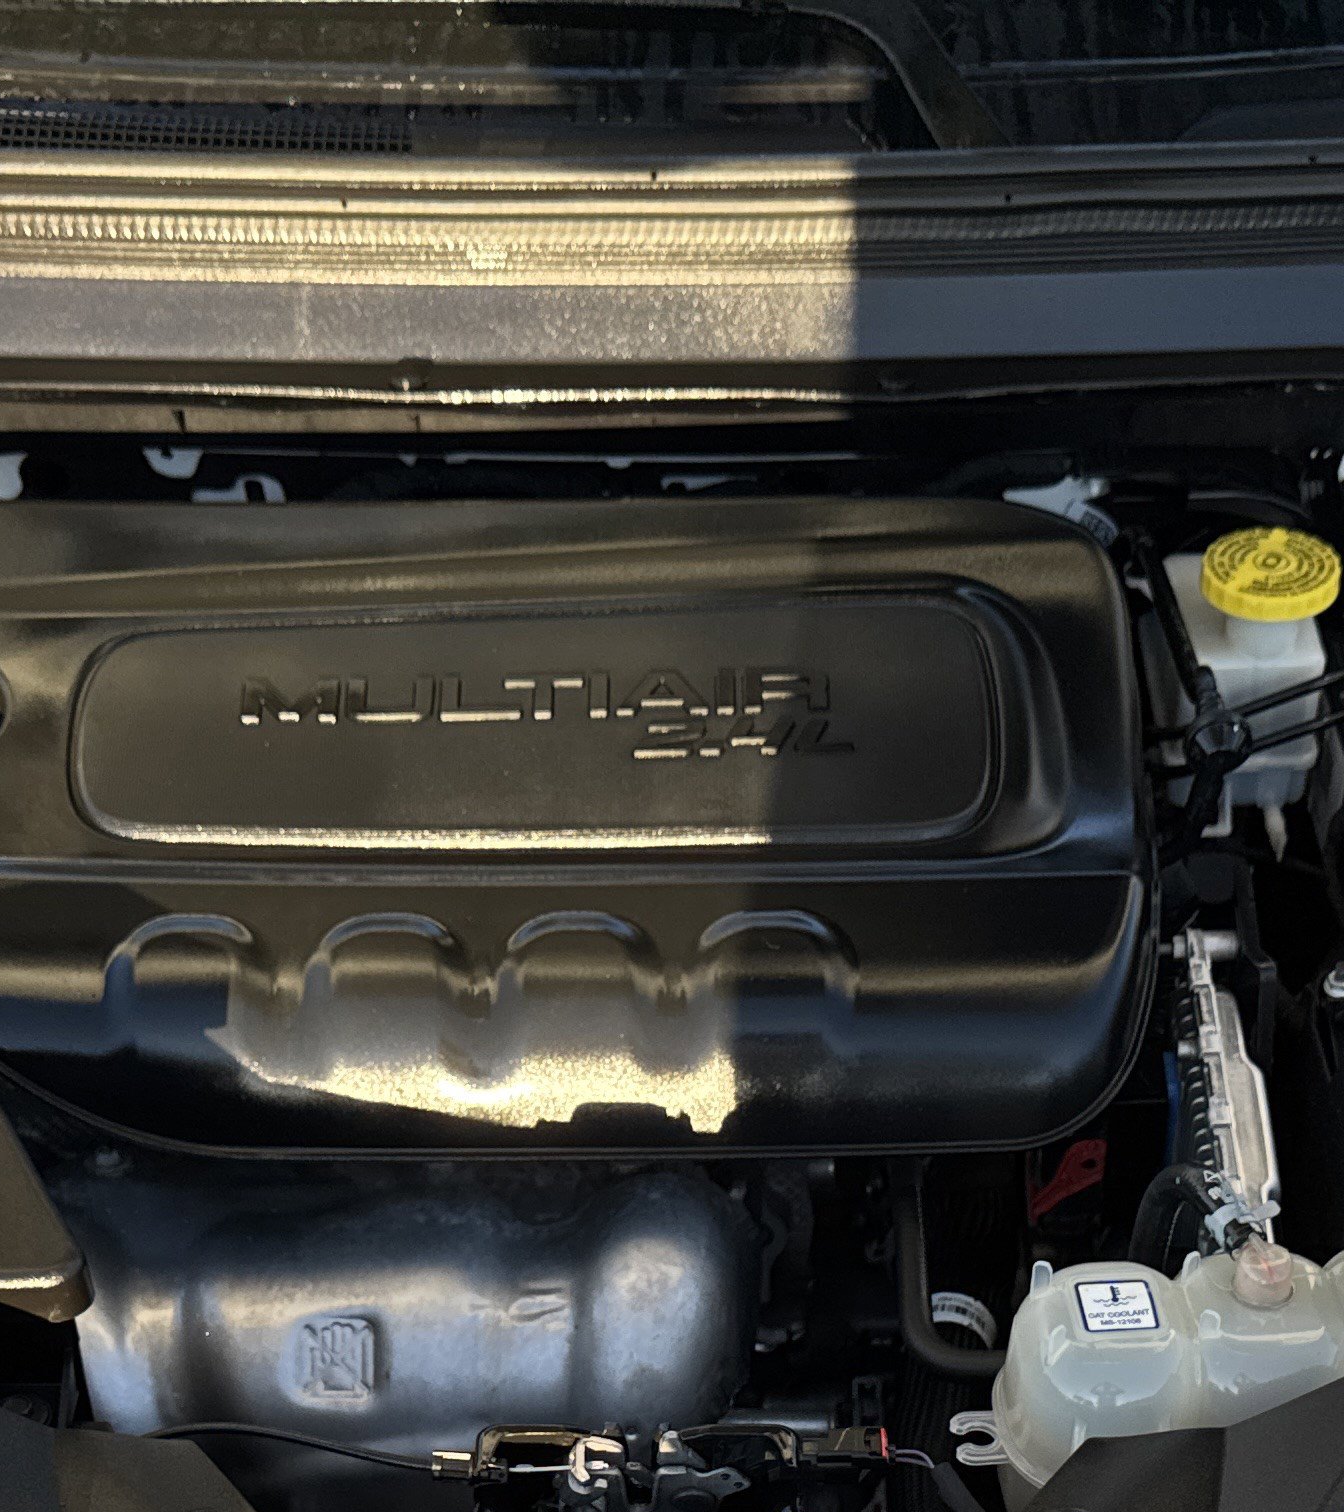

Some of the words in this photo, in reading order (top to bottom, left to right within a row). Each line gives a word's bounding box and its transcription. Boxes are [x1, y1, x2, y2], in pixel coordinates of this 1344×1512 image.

[240, 668, 830, 725] MULTIAIR
[632, 719, 855, 758] 2.4L
[1107, 1308, 1149, 1318] COOLANT
